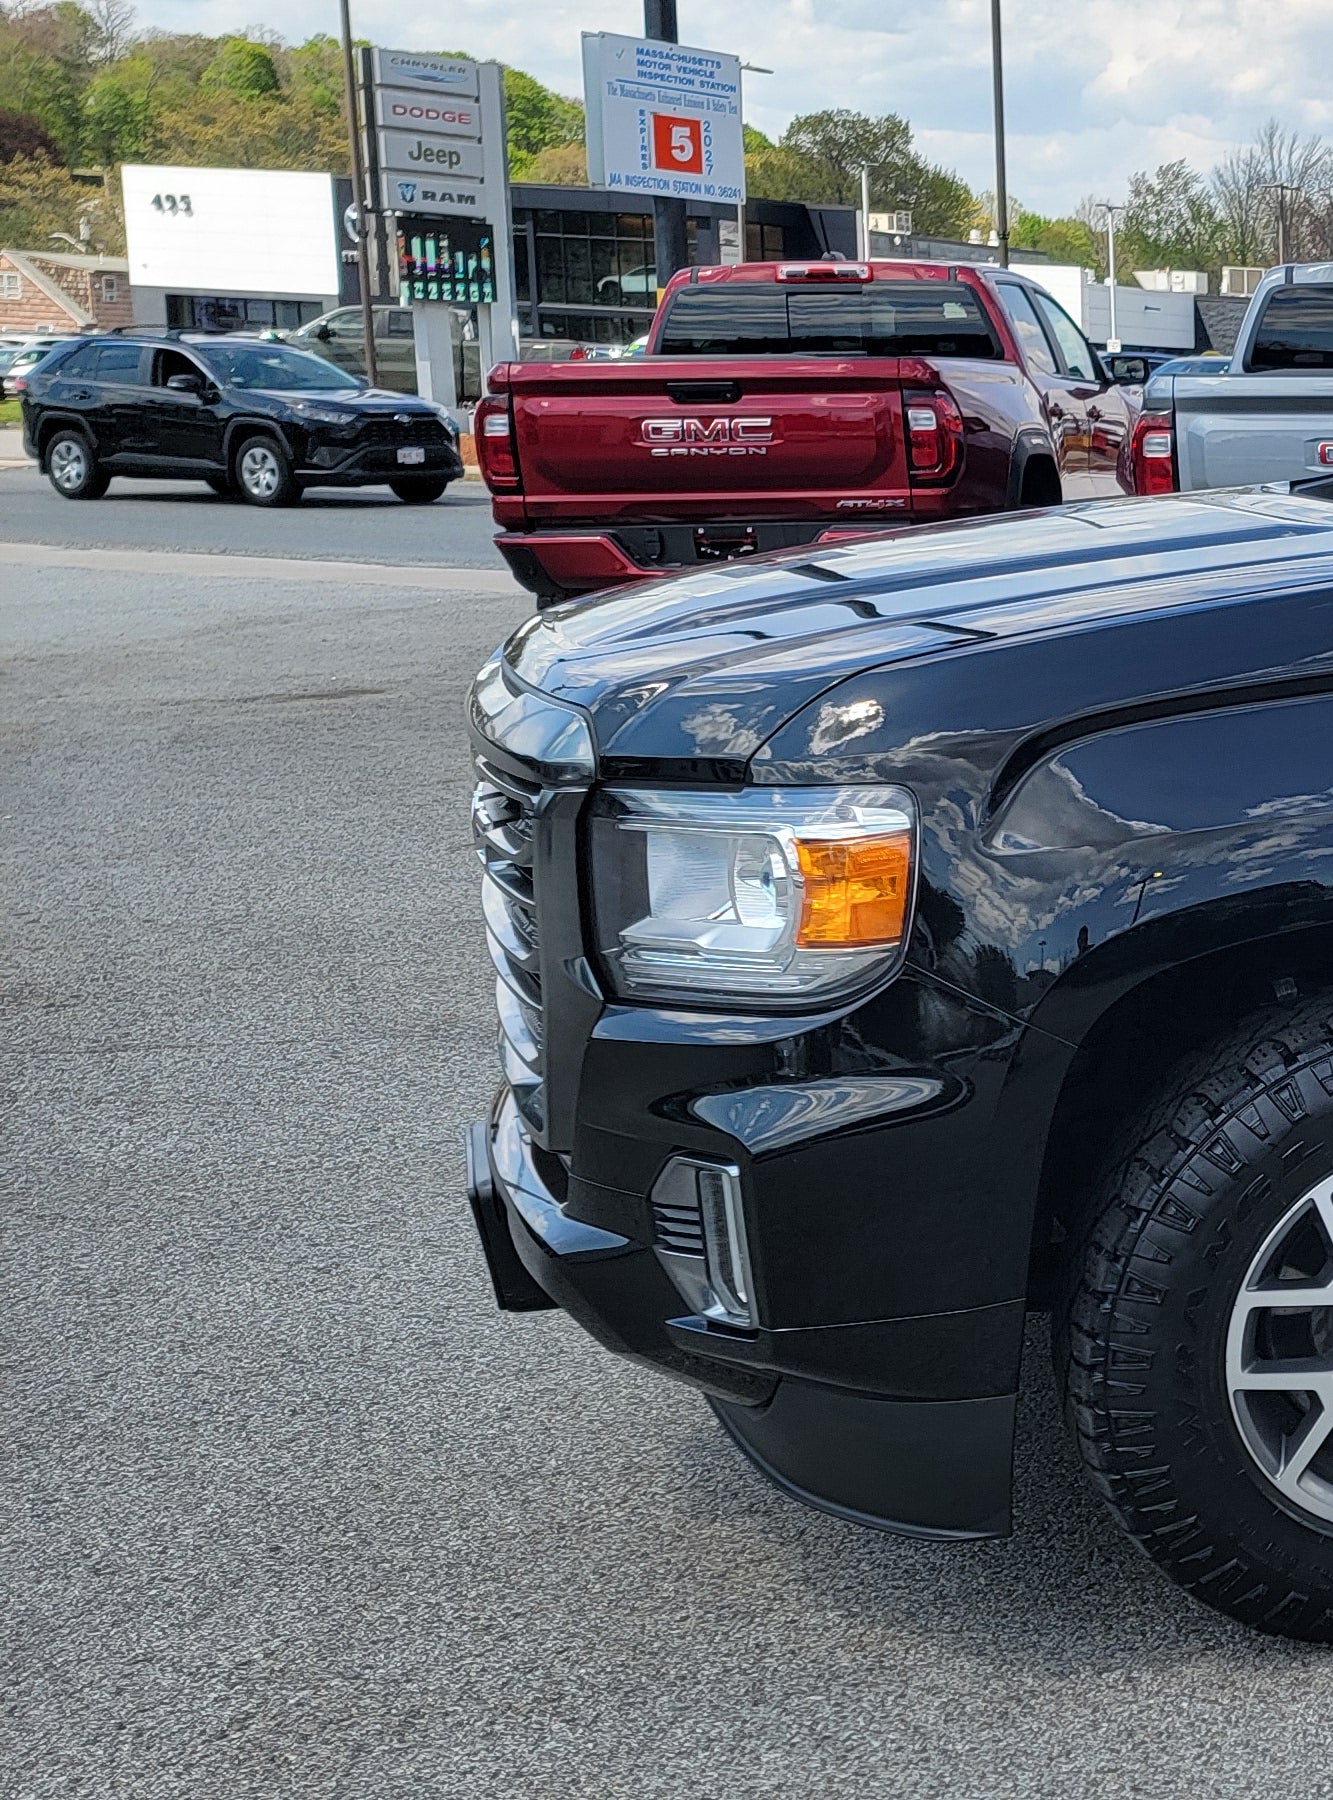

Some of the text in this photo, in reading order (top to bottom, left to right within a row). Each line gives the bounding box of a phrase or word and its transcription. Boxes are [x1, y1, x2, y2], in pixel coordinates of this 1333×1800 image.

[390, 57, 467, 75] CHRYSLER
[636, 47, 721, 69] MASSACHUSETTS
[636, 58, 715, 79] MOTOR VEHICLE
[637, 70, 737, 93] INSPECTION STATION
[392, 104, 472, 125] DODGE
[638, 109, 649, 170] EXPIRES
[671, 124, 694, 162] 5
[408, 141, 461, 169] Jeep
[609, 173, 622, 185] MA
[625, 175, 670, 191] INSPECTION
[673, 180, 701, 195] STATION
[422, 190, 476, 206] RAM
[641, 418, 773, 442] GMC
[651, 447, 767, 457] CANYON
